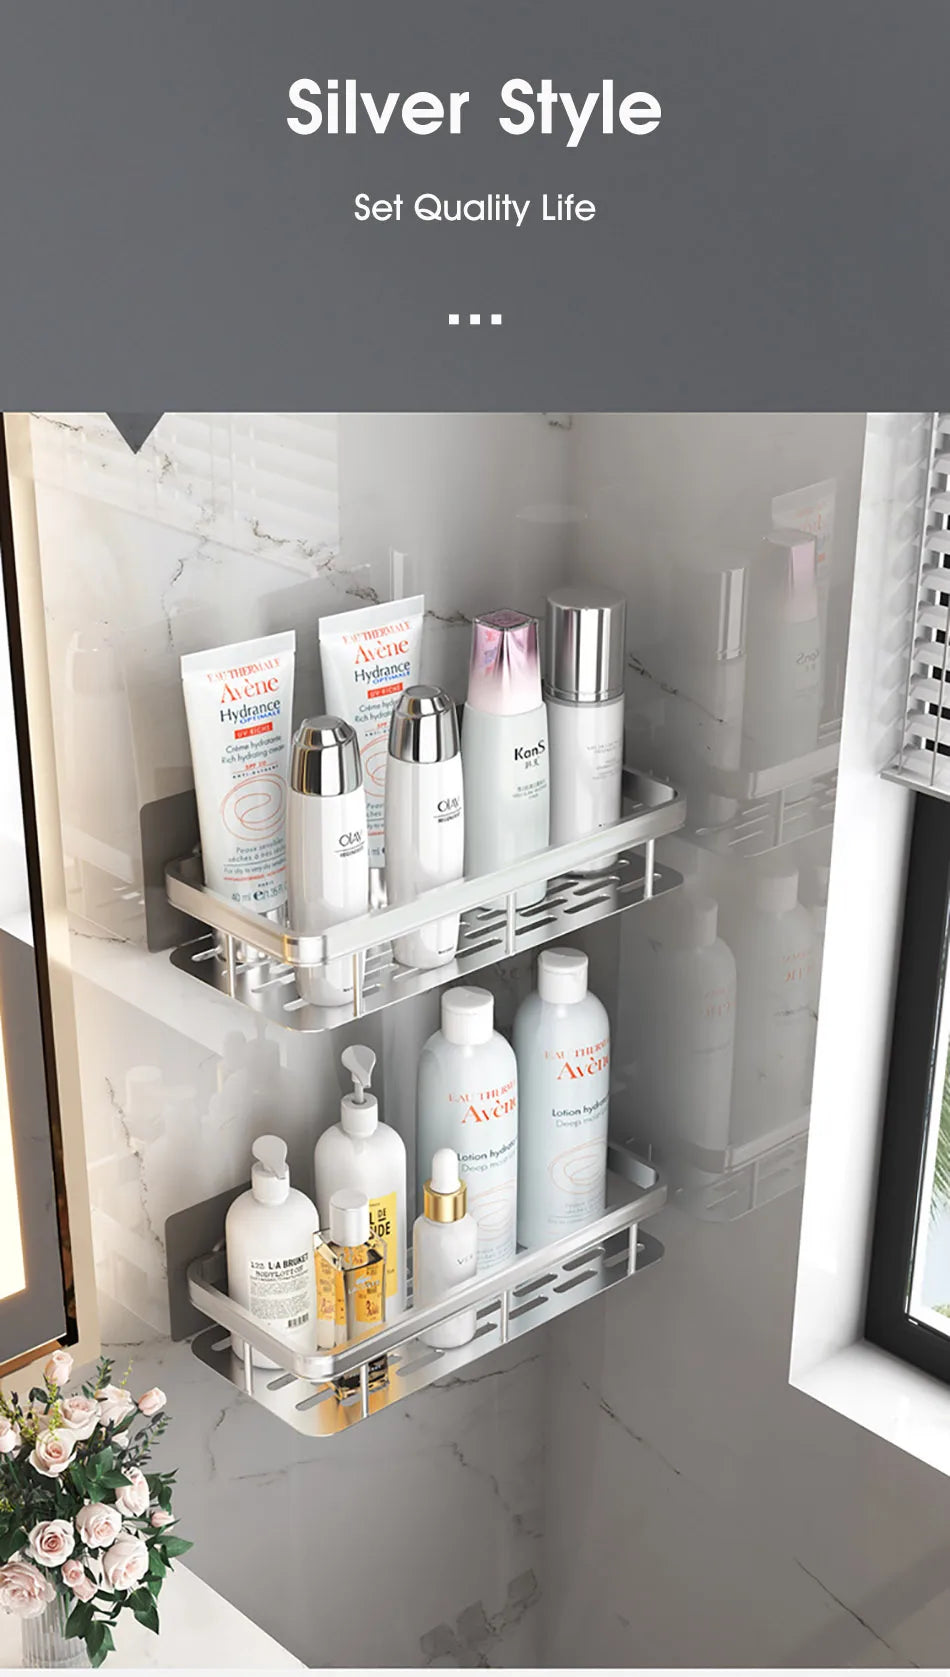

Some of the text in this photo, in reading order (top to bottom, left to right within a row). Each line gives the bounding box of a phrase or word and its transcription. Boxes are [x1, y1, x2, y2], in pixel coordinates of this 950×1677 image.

[355, 639, 410, 665] Avène
[354, 661, 411, 684] Hydrance
[220, 677, 280, 704] Avène
[220, 699, 281, 724] Hydrance
[514, 739, 546, 761] KanS
[552, 1107, 582, 1118] Lotion
[457, 1152, 488, 1162] Lotion
